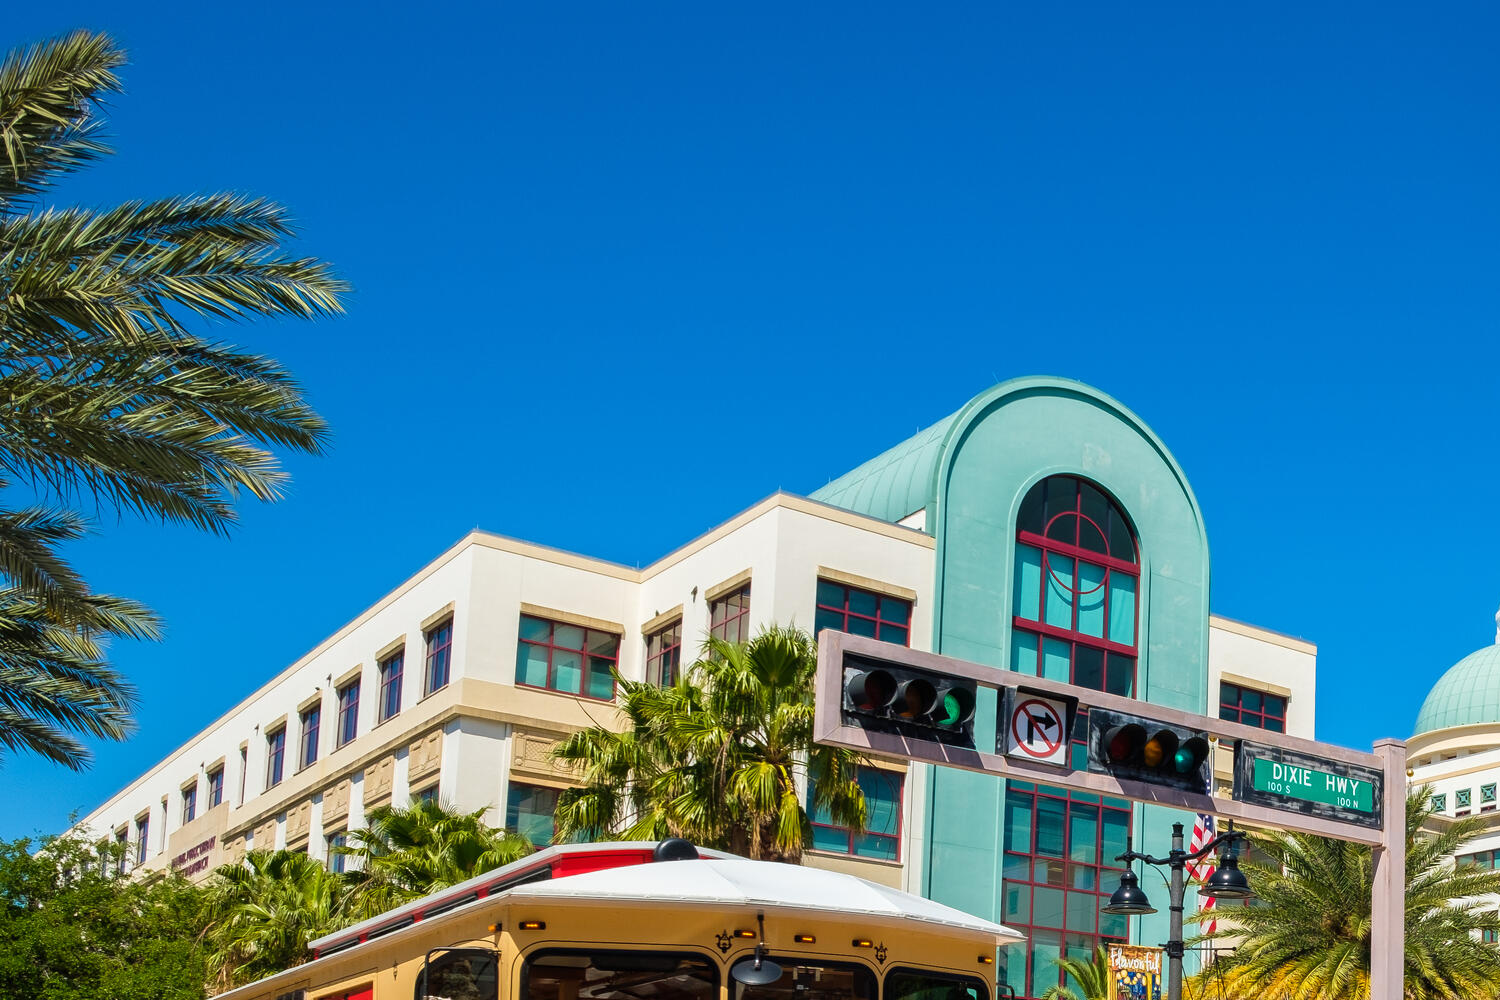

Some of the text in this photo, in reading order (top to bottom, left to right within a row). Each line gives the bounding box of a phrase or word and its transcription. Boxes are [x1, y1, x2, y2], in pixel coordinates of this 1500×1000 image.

[1267, 782, 1291, 794] 100 S
[1273, 763, 1359, 796] DIXIE HWY
[1337, 797, 1359, 808] 100 N
[1110, 947, 1160, 974] Flavorful
